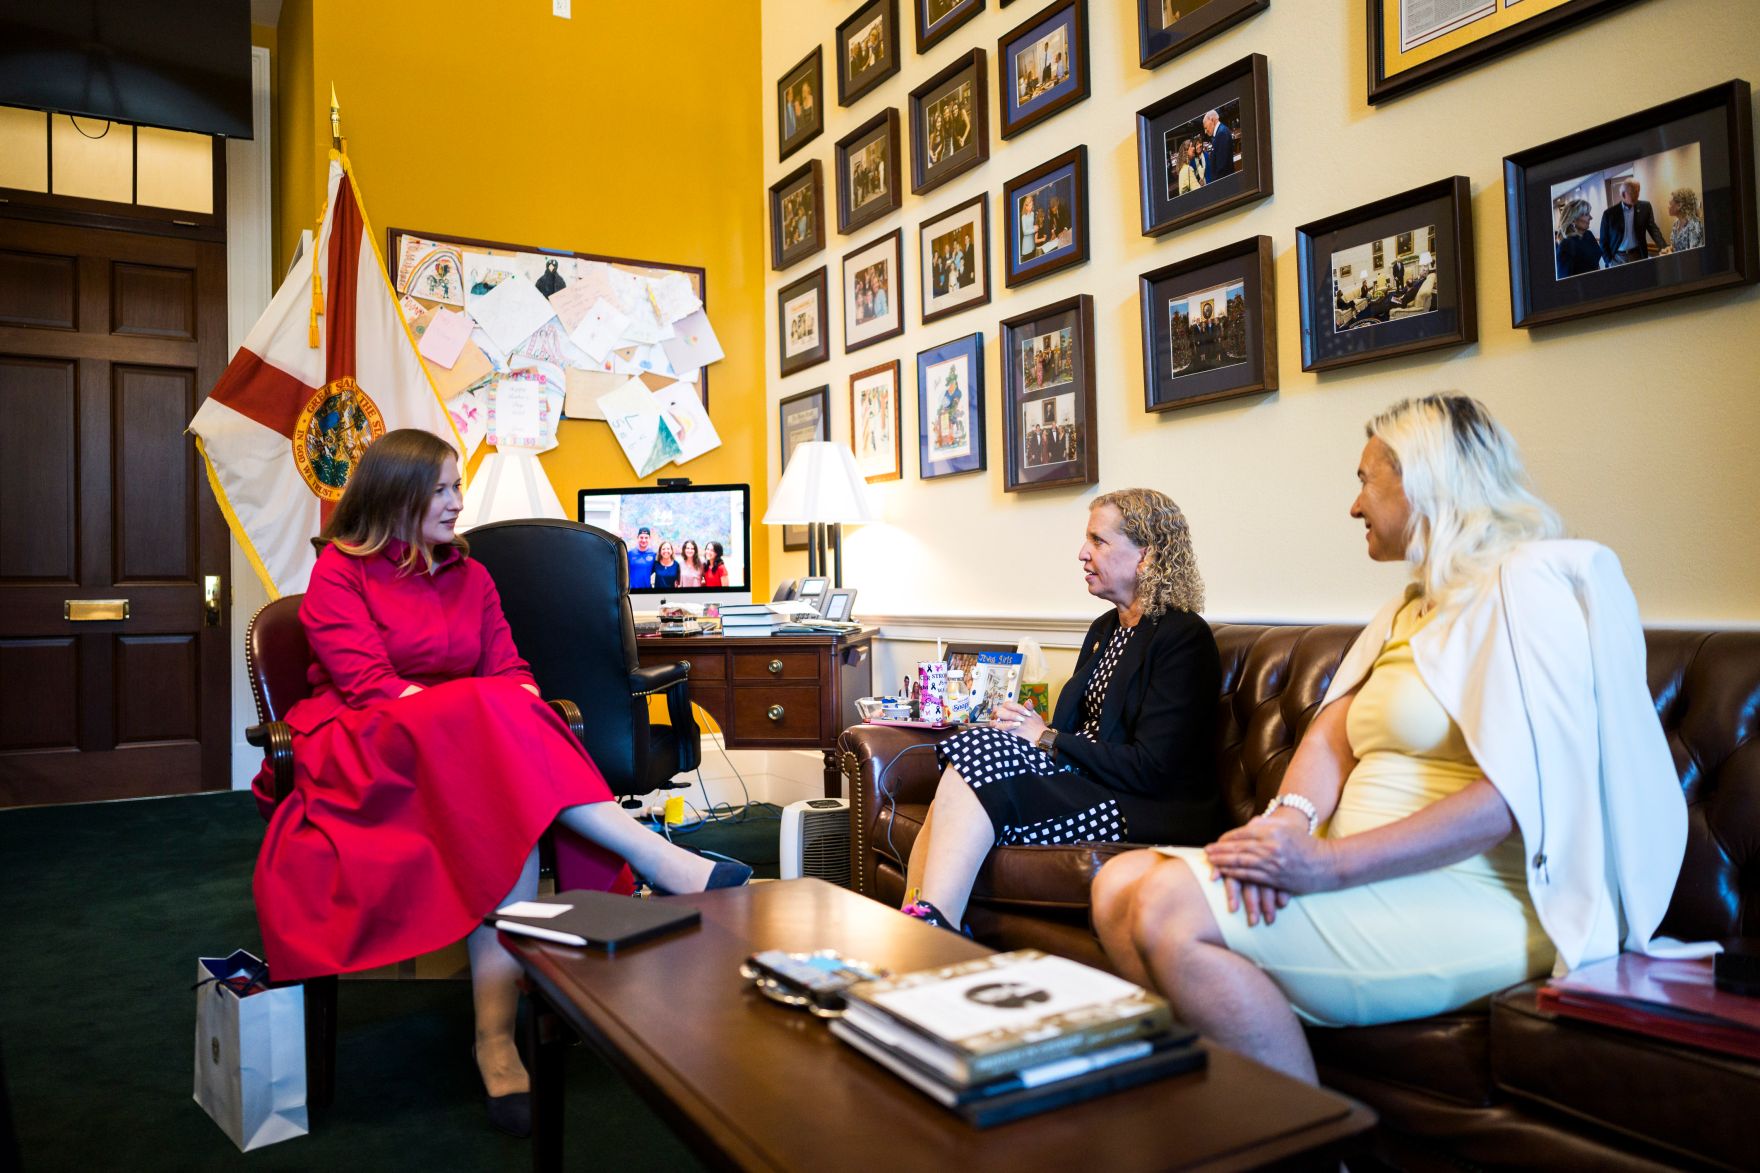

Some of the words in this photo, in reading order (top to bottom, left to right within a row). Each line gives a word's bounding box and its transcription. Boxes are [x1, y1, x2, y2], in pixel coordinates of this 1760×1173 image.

[360, 395, 376, 418] THE
[296, 430, 305, 440] IN
[296, 444, 306, 464] GOD
[302, 465, 314, 481] WE
[312, 480, 334, 498] TRUST
